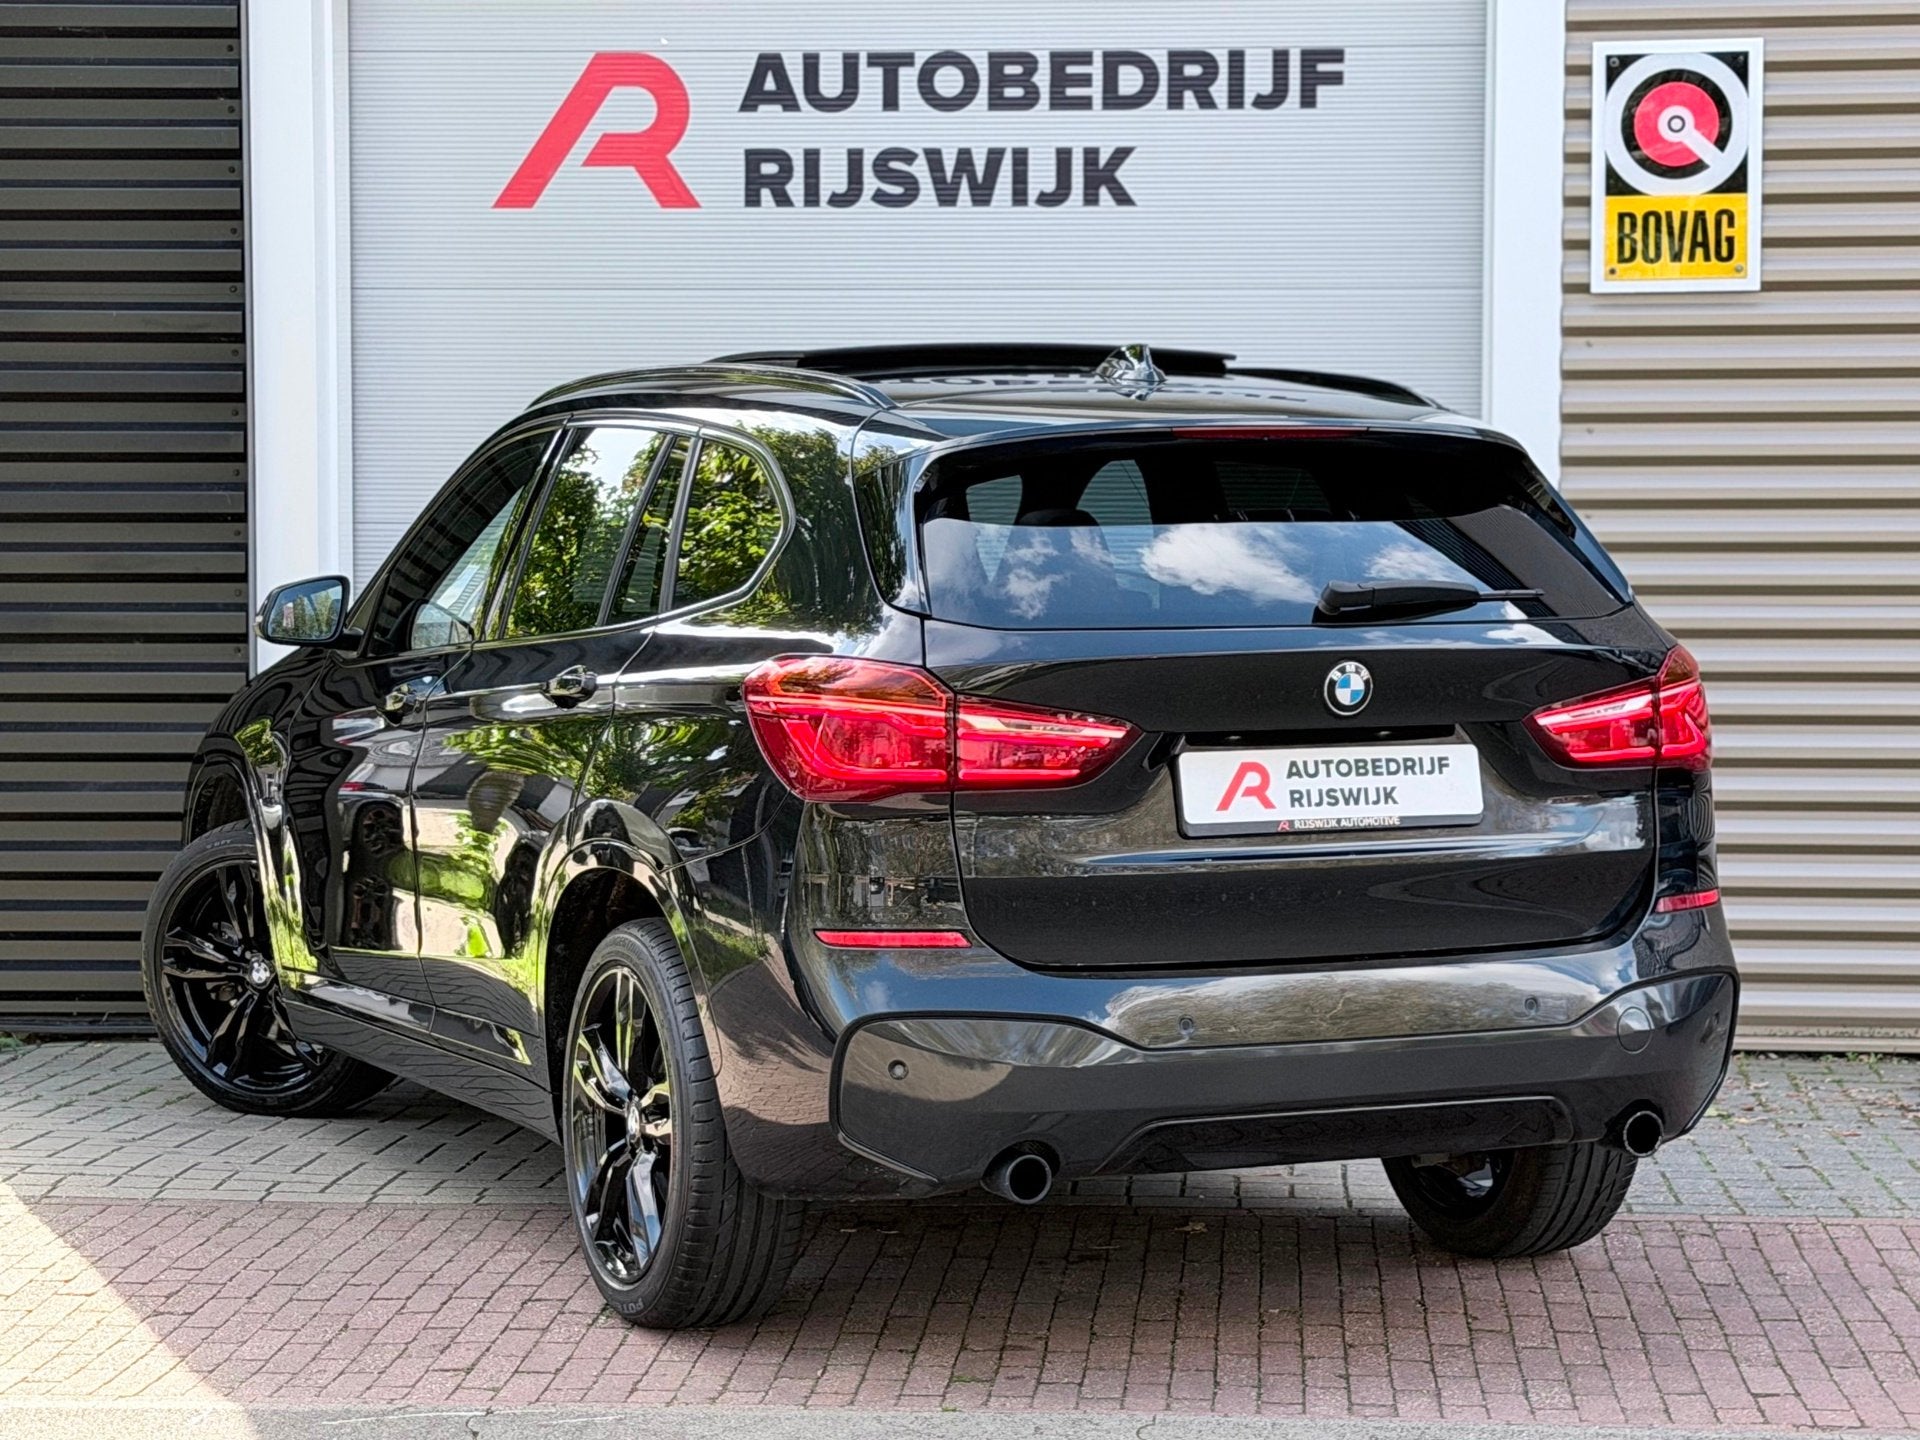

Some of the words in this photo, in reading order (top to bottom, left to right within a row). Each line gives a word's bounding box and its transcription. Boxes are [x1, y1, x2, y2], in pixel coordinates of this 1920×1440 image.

[740, 49, 1344, 112] AUTOBEDRIJF
[744, 147, 1137, 208] RIJSWIJK
[1617, 209, 1735, 264] BOVAG
[1286, 756, 1450, 779] AUTOBEDRIJF
[1289, 786, 1399, 808] RIJSWIJK
[1294, 818, 1338, 829] RIJSWIJK
[1340, 815, 1401, 827] AUTOMOTIVE
